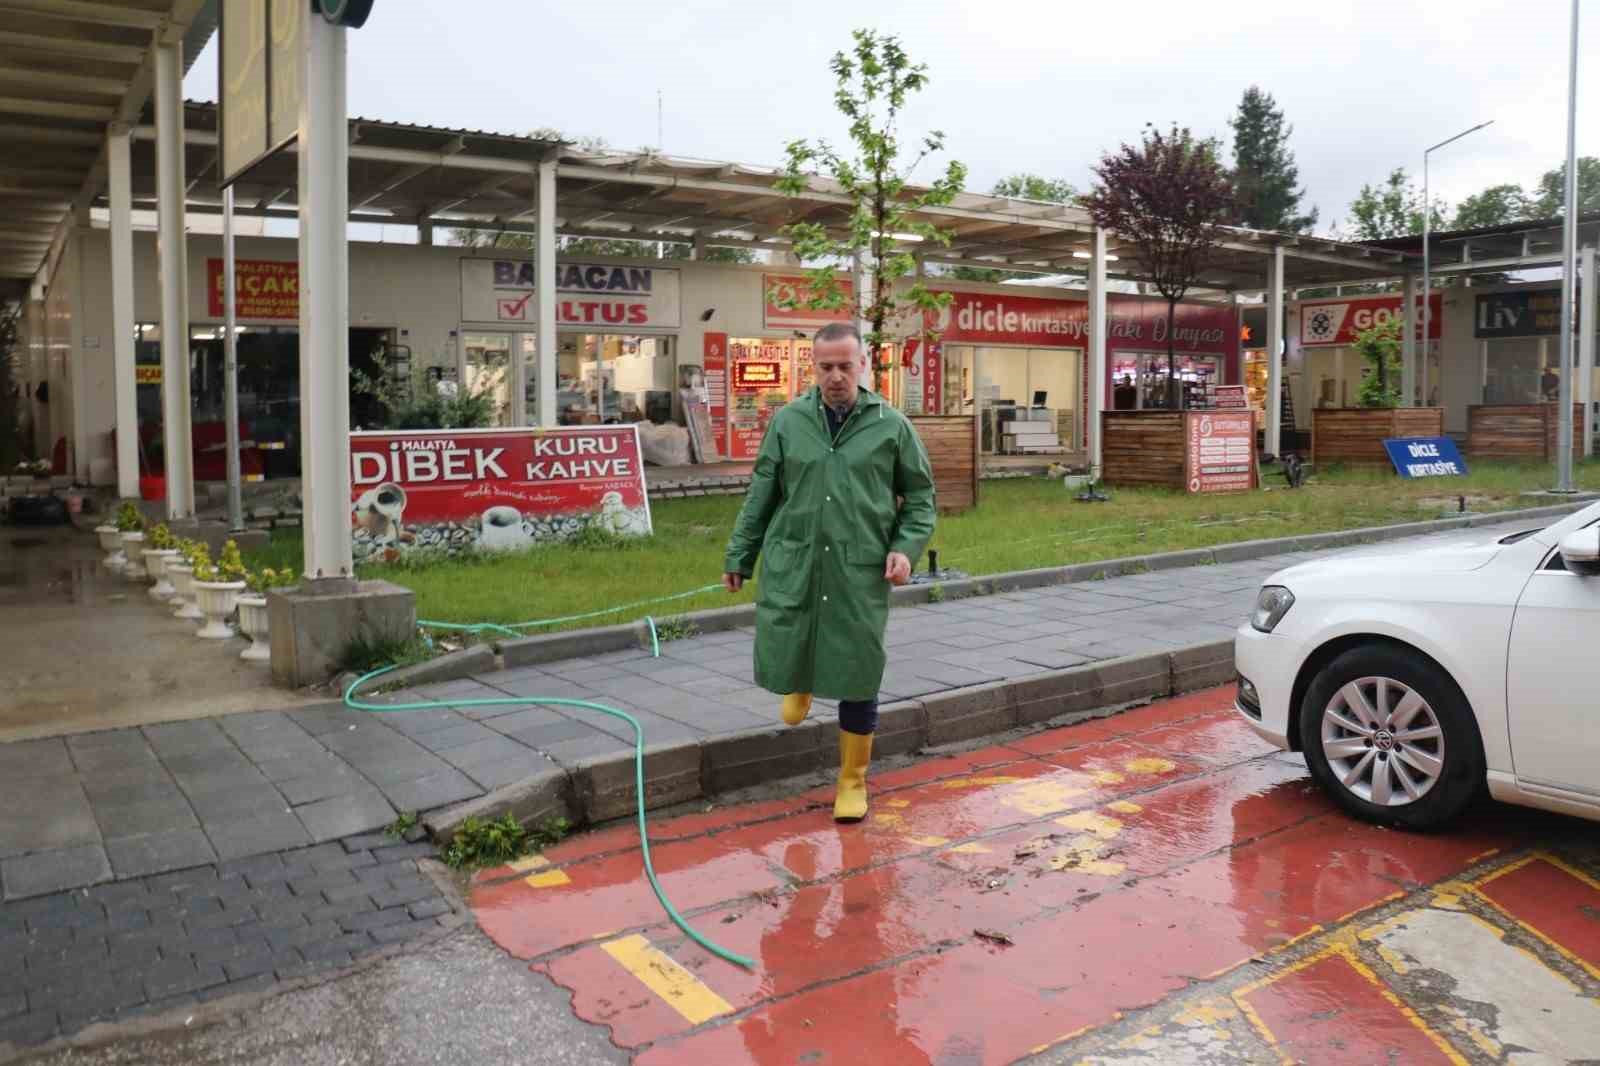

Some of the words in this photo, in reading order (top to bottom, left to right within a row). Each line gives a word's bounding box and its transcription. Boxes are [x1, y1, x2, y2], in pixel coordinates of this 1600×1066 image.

[494, 261, 652, 291] BAACAN
[556, 301, 648, 324] LTUS
[959, 302, 1019, 332] dicle
[1151, 316, 1225, 345] Dnyası
[402, 440, 456, 451] MALATYA
[535, 437, 618, 456] KURU
[1408, 443, 1440, 457] DİCLE
[527, 459, 632, 480] KAHVE
